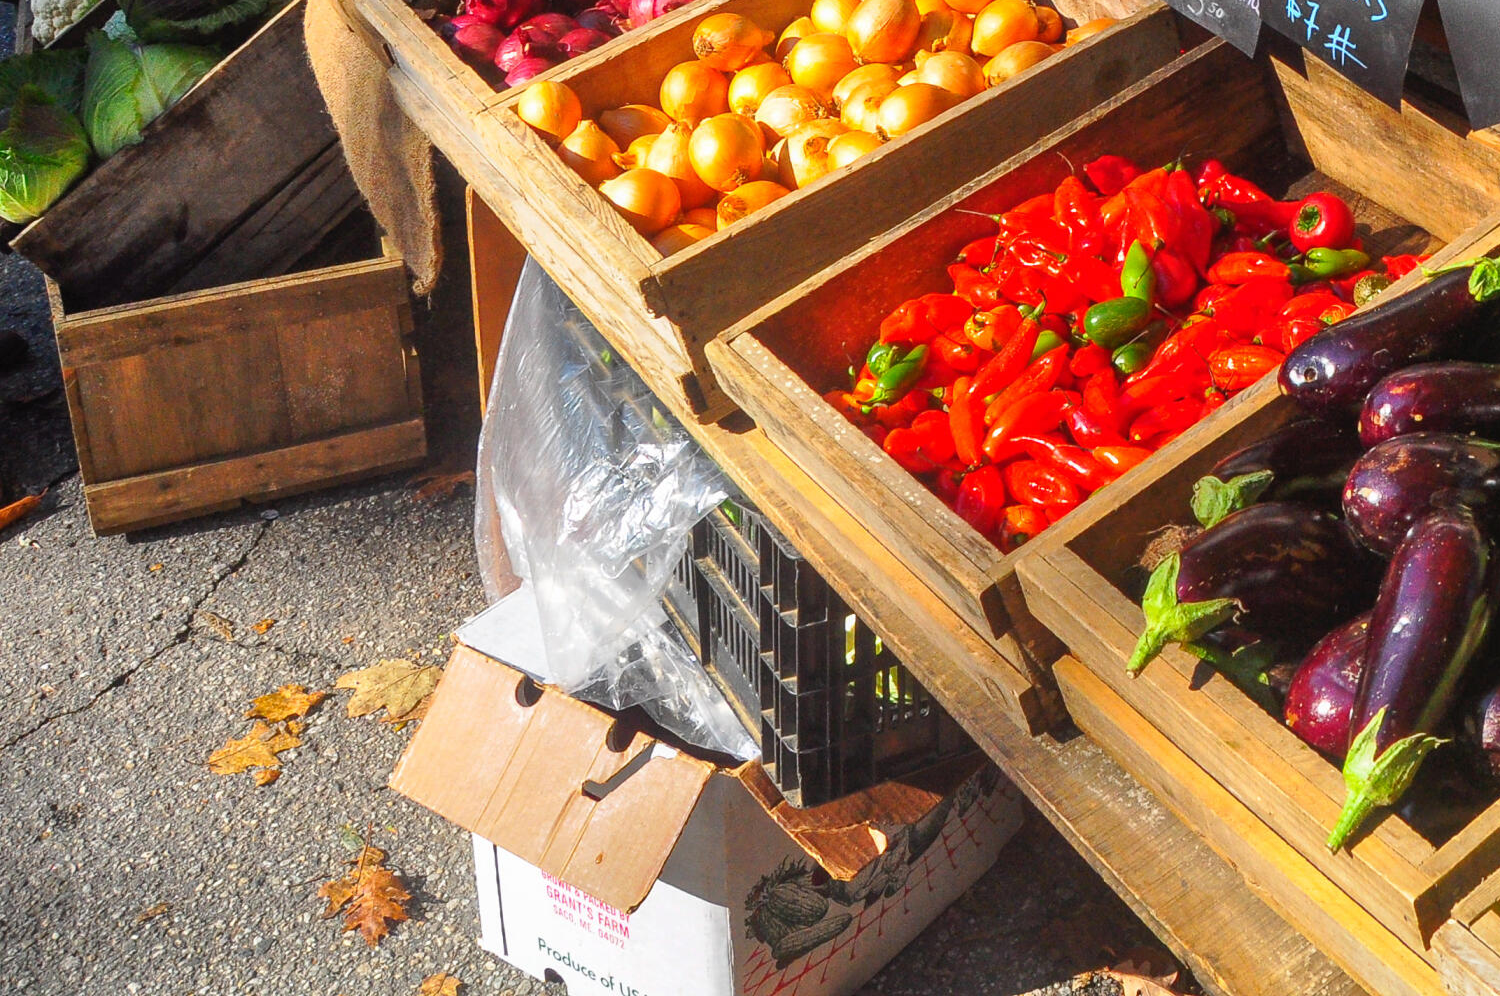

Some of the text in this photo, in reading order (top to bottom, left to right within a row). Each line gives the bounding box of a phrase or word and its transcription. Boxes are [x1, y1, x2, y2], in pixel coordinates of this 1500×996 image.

[546, 885, 630, 939] GRANT'S FARM
[537, 937, 647, 996] Produce of US
